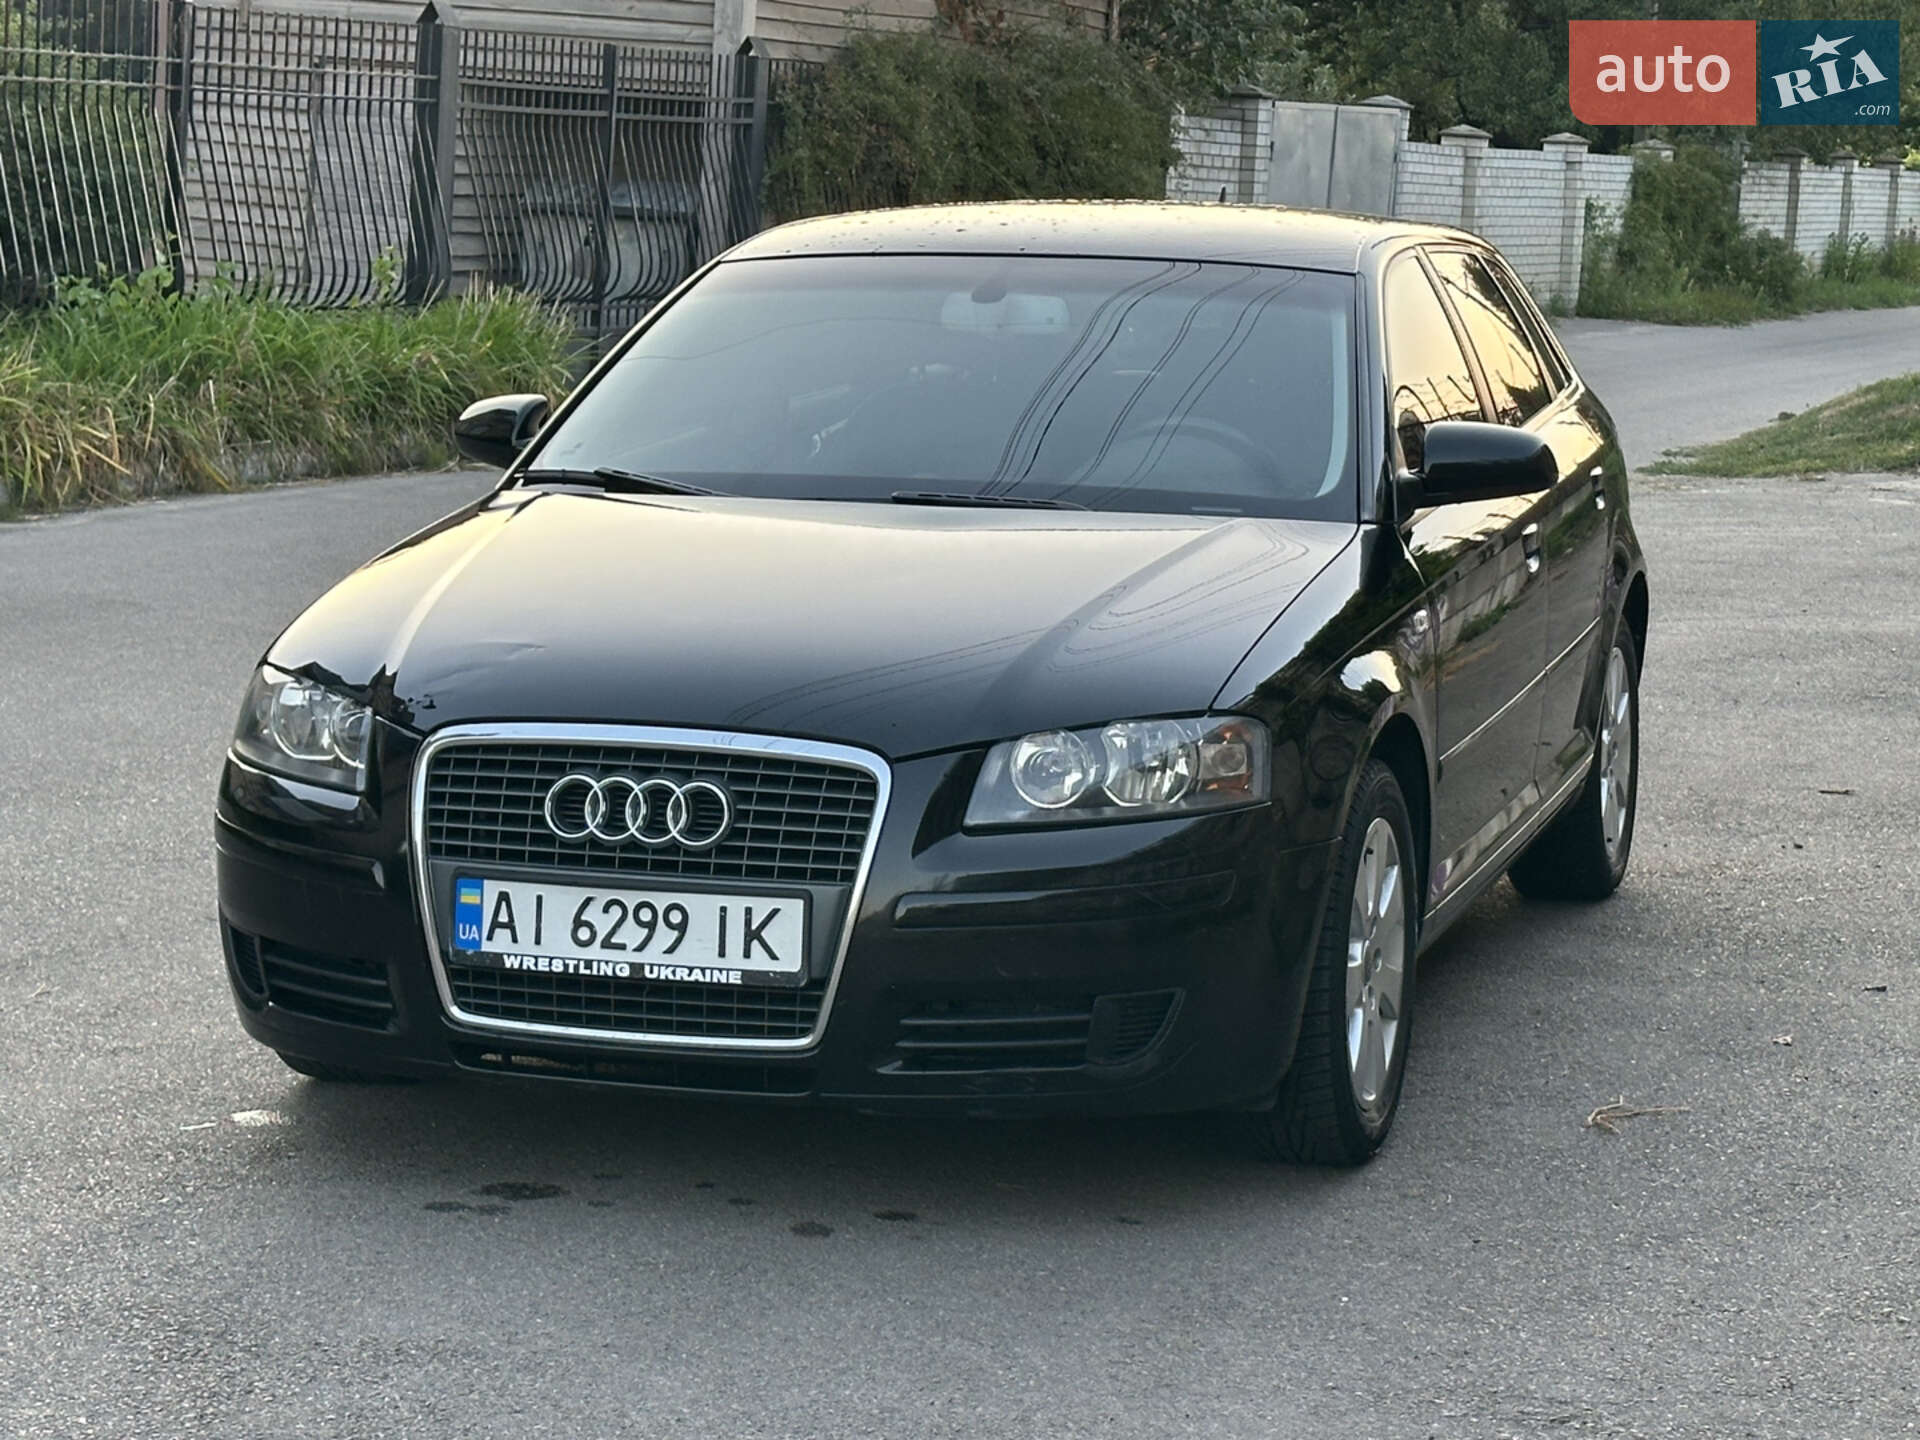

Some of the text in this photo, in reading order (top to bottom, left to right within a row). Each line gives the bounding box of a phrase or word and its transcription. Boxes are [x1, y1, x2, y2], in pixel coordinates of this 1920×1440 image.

[458, 923, 480, 942] UA
[486, 890, 782, 961] AI 6299 IK
[502, 954, 743, 984] WRESTLING UKRAINE
